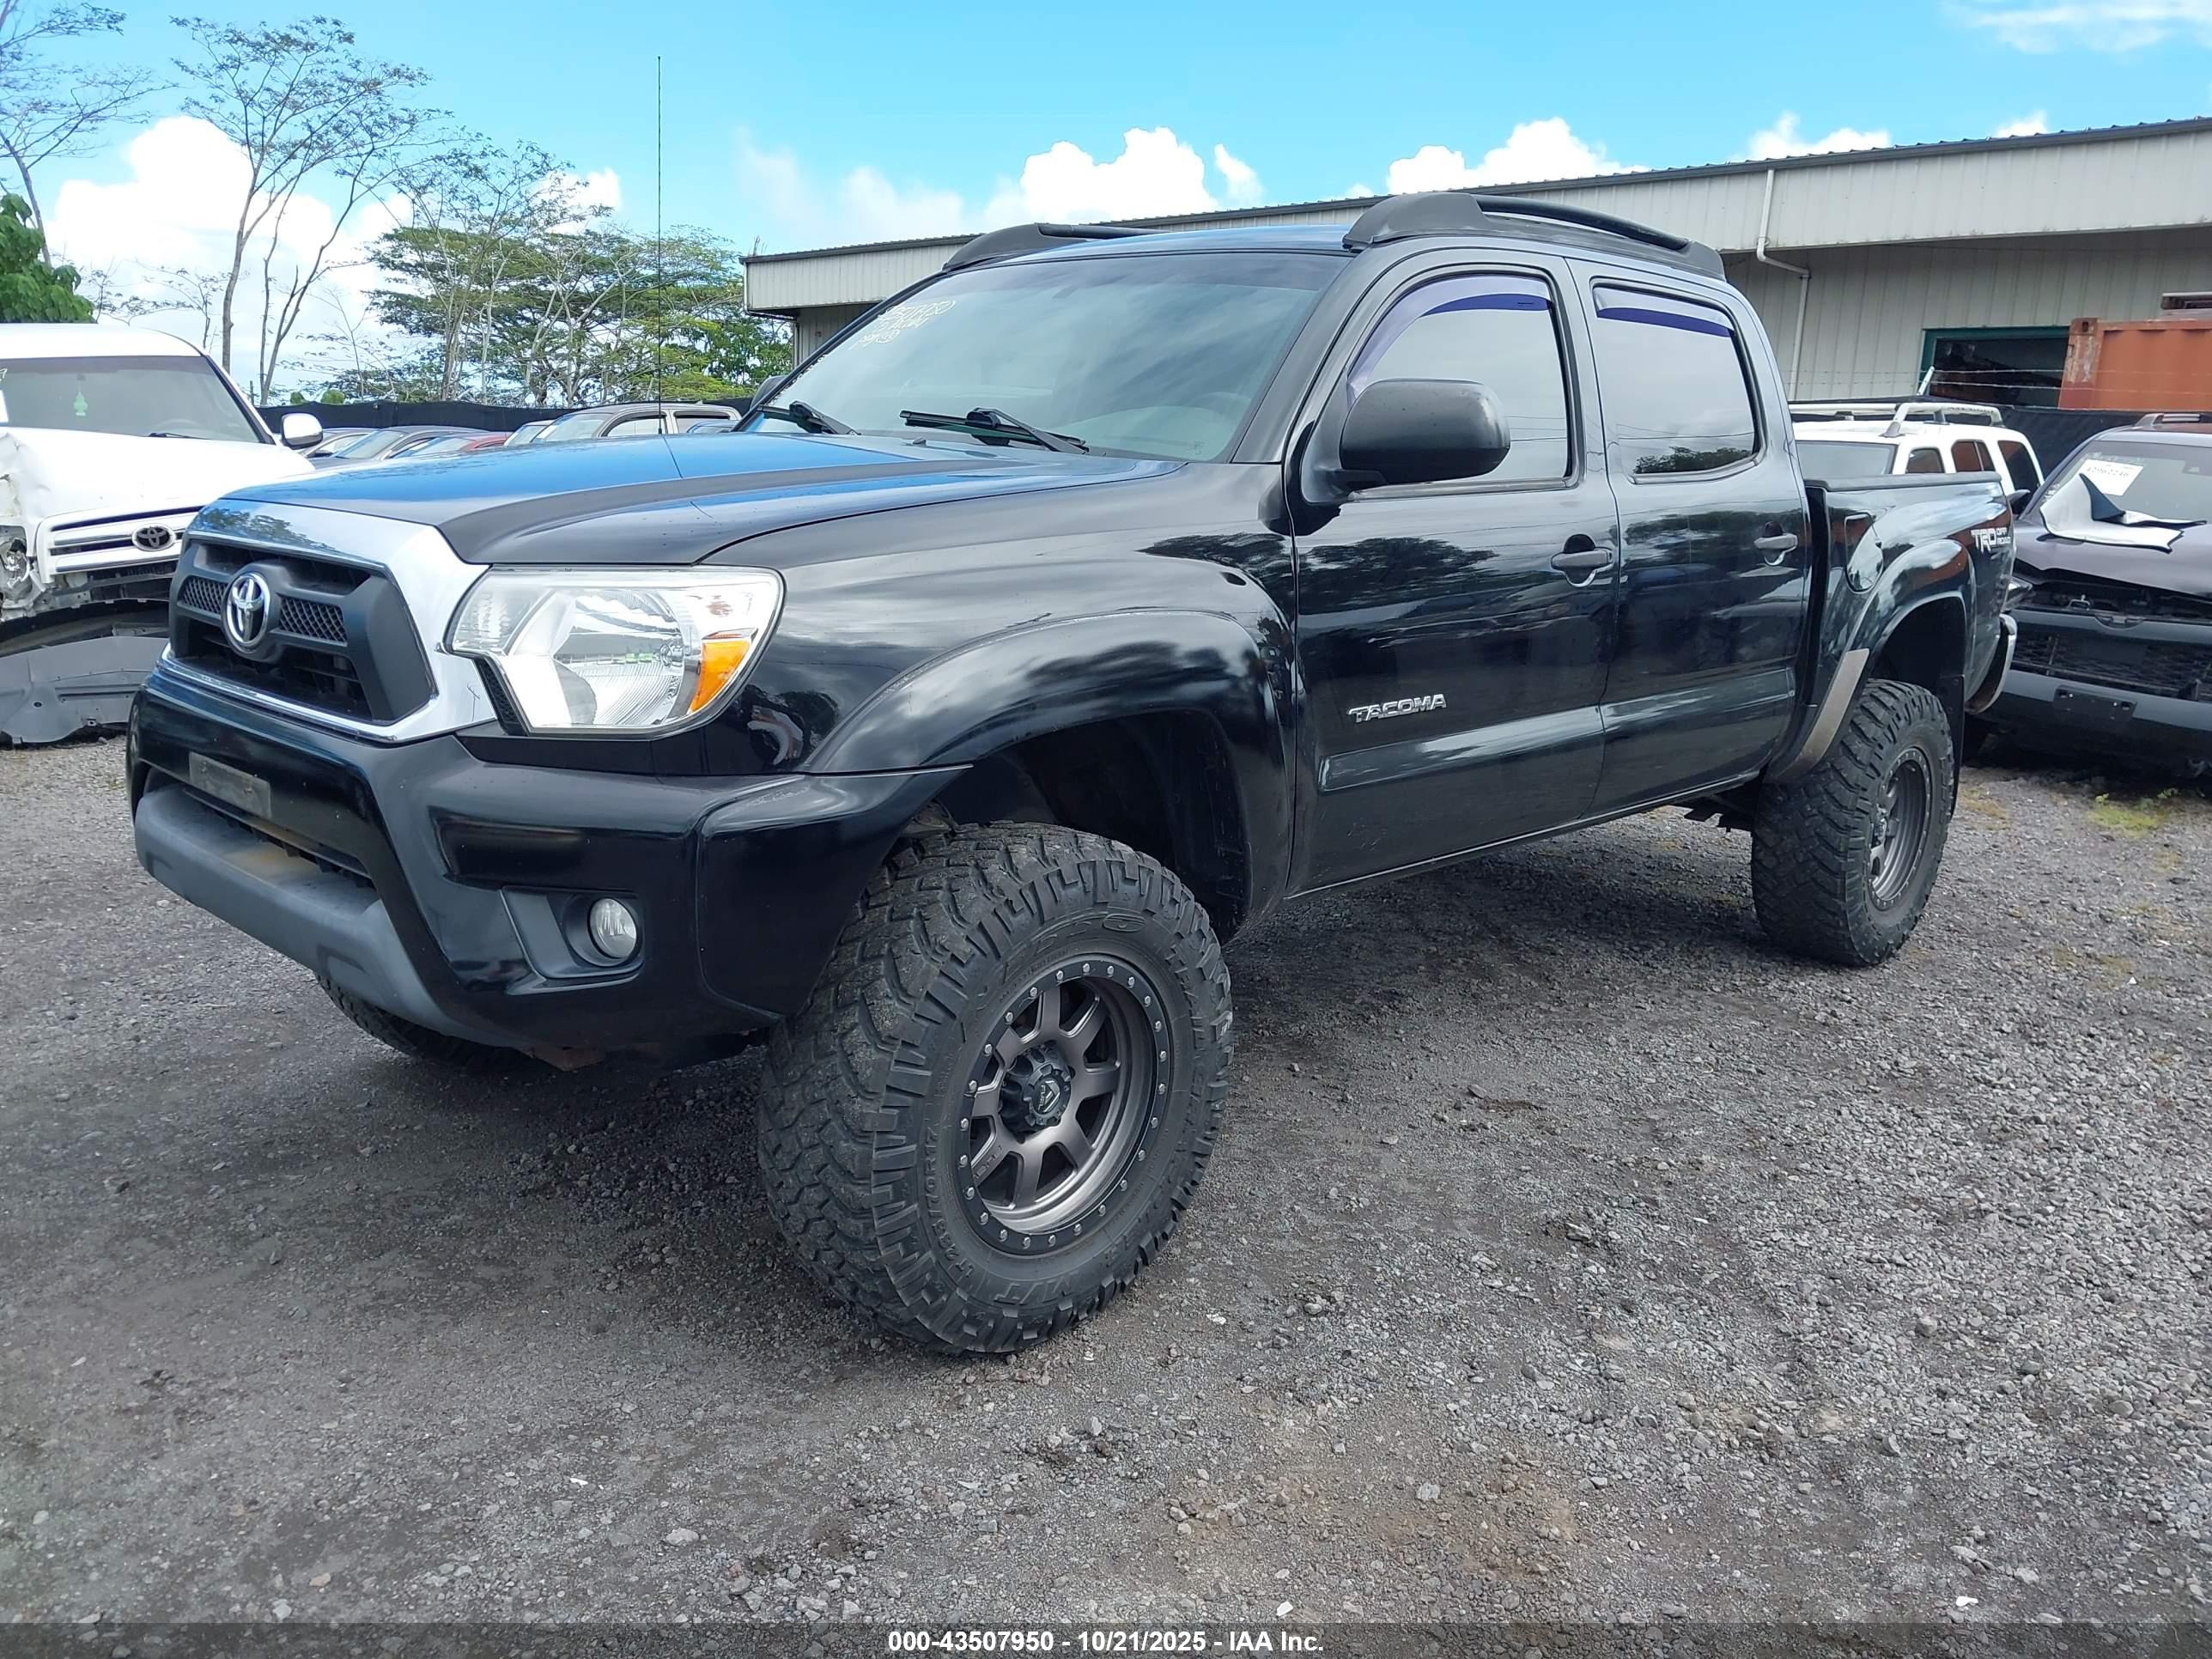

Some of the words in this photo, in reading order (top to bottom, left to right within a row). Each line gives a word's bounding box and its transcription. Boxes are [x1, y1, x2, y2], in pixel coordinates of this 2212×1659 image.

[1971, 528, 1996, 554] TRD
[1996, 526, 2008, 536] OFF
[1347, 693, 1447, 723] TACOMA
[1036, 1084, 1048, 1112] FUEL
